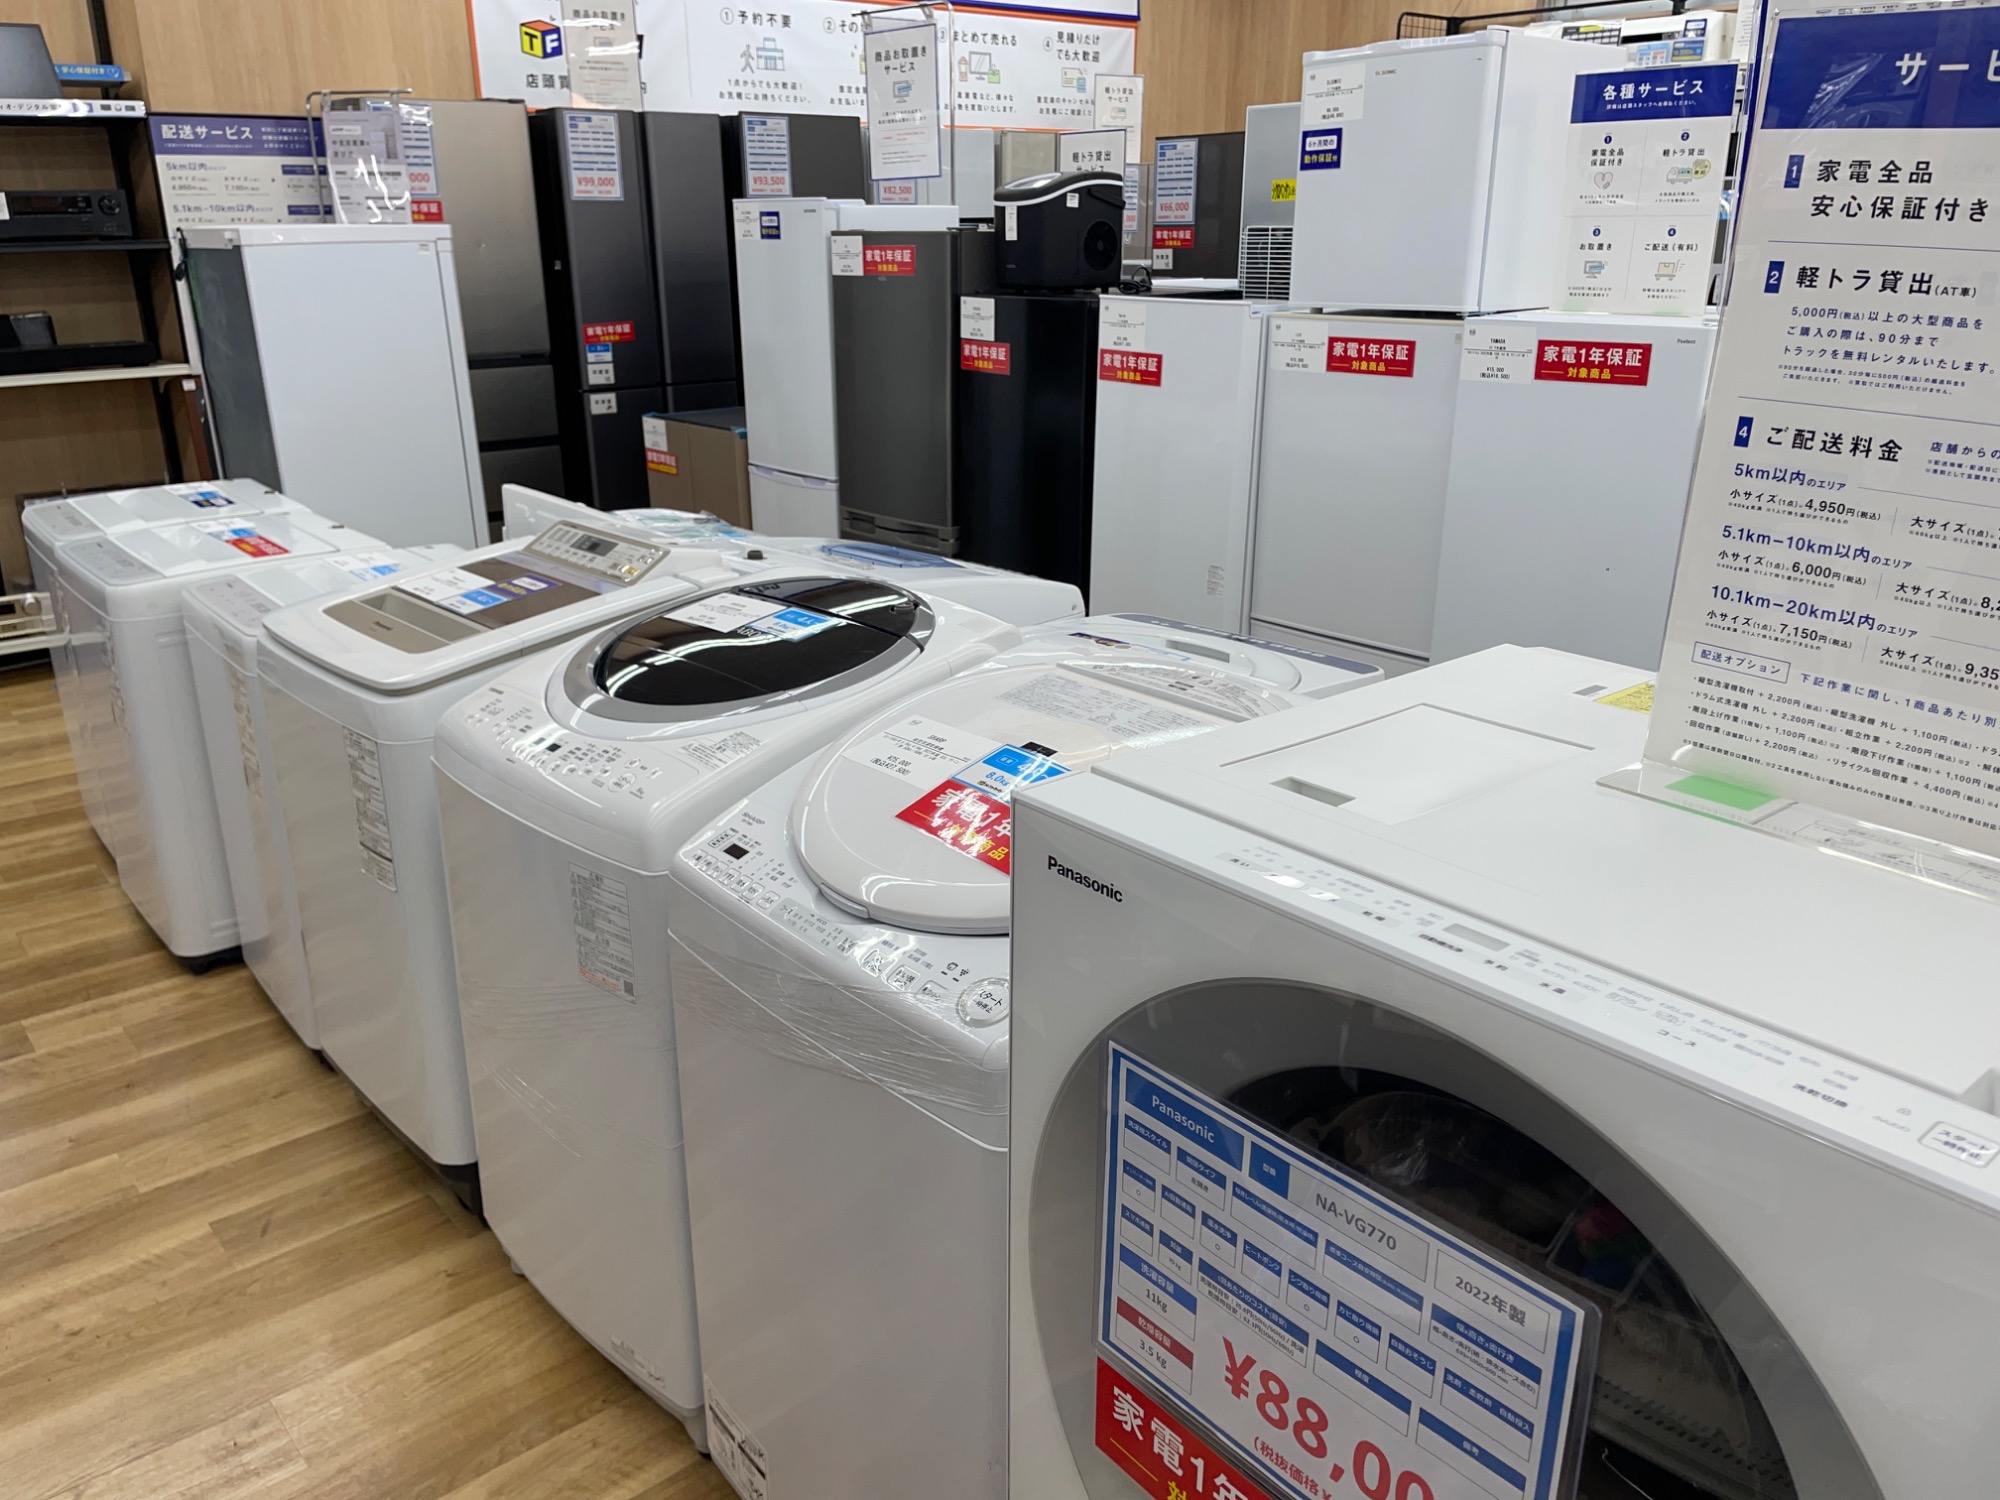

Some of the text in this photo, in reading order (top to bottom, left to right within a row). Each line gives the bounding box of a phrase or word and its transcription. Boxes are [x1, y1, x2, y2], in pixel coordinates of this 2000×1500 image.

[738, 10, 792, 28] 予約不要
[1056, 31, 1101, 46] 見積りだけ
[875, 46, 927, 62] 商品お取置き
[1056, 49, 1100, 63] でも大歓迎
[884, 62, 916, 75] サービス
[1602, 79, 1704, 101] 各種サービス
[943, 103, 1017, 114] お物を買取いたします。
[161, 124, 254, 141] 配送サービス
[1072, 150, 1112, 164] 軽トラ貸出
[1591, 148, 1625, 157] 家電全品
[1662, 148, 1706, 158] 軽トラ貸出
[1590, 158, 1623, 167] 保証付き
[1816, 159, 1934, 185] 家電全品
[577, 177, 616, 187] ¥99,000
[752, 176, 786, 186] ¥93,500
[1159, 202, 1190, 212] ¥66,000
[1810, 195, 1990, 223] 安心保証付き
[1155, 230, 1192, 240] 家電1年保証
[865, 250, 912, 262] 家電1年保証
[1579, 243, 1613, 251] お取置き
[1790, 305, 1985, 332] 5,000円(税込)以上の大型商品を
[1786, 325, 1940, 349] ご購入の際は、90分まで
[963, 344, 1007, 361] 家電1年保証
[1332, 341, 1410, 361] 家電1年保証
[1542, 345, 1644, 367] 家電1年保証
[1783, 345, 1996, 375] トラックを無料レンタルいたします。
[1102, 353, 1159, 372] 家電1年保証
[1351, 360, 1386, 372] 対象商品
[1566, 366, 1612, 380] 対象商品
[1766, 426, 1904, 463] ご配送料金
[1733, 463, 1848, 492] 5km以内のエリア
[1700, 649, 1782, 676] 配送オプション
[1800, 673, 2000, 729] 下記作業に関し、1商品あたり別
[1047, 855, 1124, 904] Panasonic
[1151, 1093, 1216, 1145] Panasonic
[1315, 1192, 1397, 1251] NA-VG770
[1140, 1262, 1176, 1295] 洗濯容量
[1145, 1288, 1169, 1314] 11kg
[1454, 1276, 1526, 1328] 2022年製
[1137, 1316, 1172, 1348] 乾燥容量
[1138, 1338, 1168, 1370] 3.5 kg
[1390, 1338, 1435, 1371] 自動おそうじ
